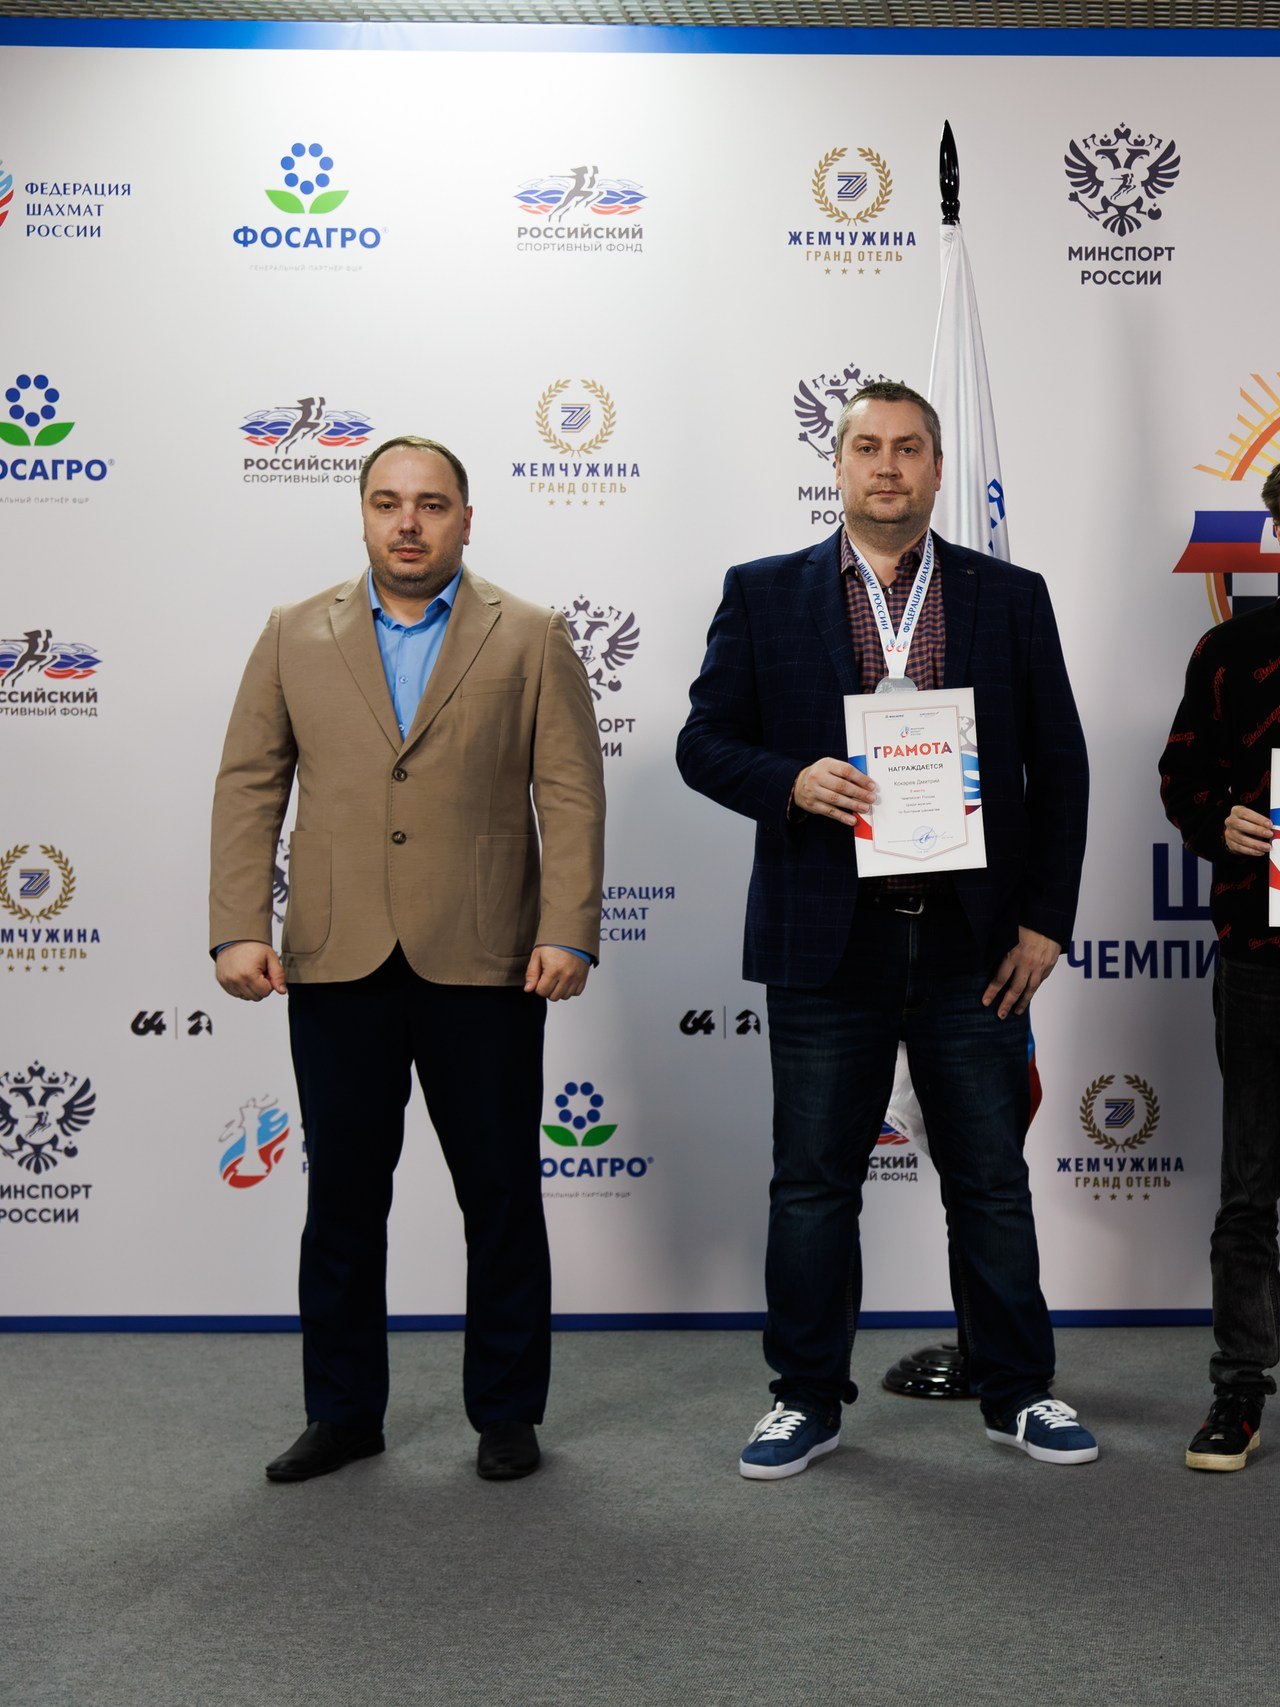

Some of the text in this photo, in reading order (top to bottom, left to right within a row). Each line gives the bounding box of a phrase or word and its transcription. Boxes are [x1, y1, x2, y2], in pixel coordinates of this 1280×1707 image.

[25, 182, 130, 196] ФЕДЕРАЦИЯ
[27, 203, 103, 216] ШАХМАТ
[27, 225, 100, 237] РОССИИ
[518, 224, 643, 239] РОССИЙСКИЙ
[788, 232, 916, 246] ЖЕМЧУЖИНА
[517, 241, 643, 253] СПОРТИВНЫЙ ФОНД
[1069, 246, 1175, 261] МИНСПОРТ
[806, 251, 902, 263] ГРАНД ОТЕЛЬ
[1081, 270, 1161, 285] РОССИИ
[0, 459, 107, 481] САГРО
[512, 461, 640, 478] ЖЕМЧУЖИНА
[243, 473, 361, 484] СПОРТИВНЫЙ ФОН
[530, 482, 626, 495] ГРАНД ОТЕЛЬ
[903, 551, 932, 633] ФЕДЕРАЦИЯ ШАХМАТ
[873, 592, 889, 630] РОССИИ
[0, 688, 97, 703] СИЙСКИЙ
[0, 706, 98, 717] ТИВНЫЙ ФОНД
[873, 741, 953, 759] ГРАМОТА
[888, 763, 944, 773] НАГРАЖДАЕТСЯ
[601, 886, 675, 901] ЕРАЦИЯ
[600, 907, 647, 920] ХМАТ
[1, 928, 100, 943] МЧУЖИНА
[0, 948, 87, 960] РАНД ОТЕЛЬ
[1066, 939, 1219, 979] ЧЕМПИ
[541, 1157, 647, 1179] ОСАГРО
[1057, 1157, 1185, 1173] ЖЕМЧУЖИНА
[881, 1172, 918, 1182] ФОНД
[1074, 1175, 1171, 1191] ГРАНД ОТЕЛЬ
[0, 1184, 92, 1199] ИНСПОРТ
